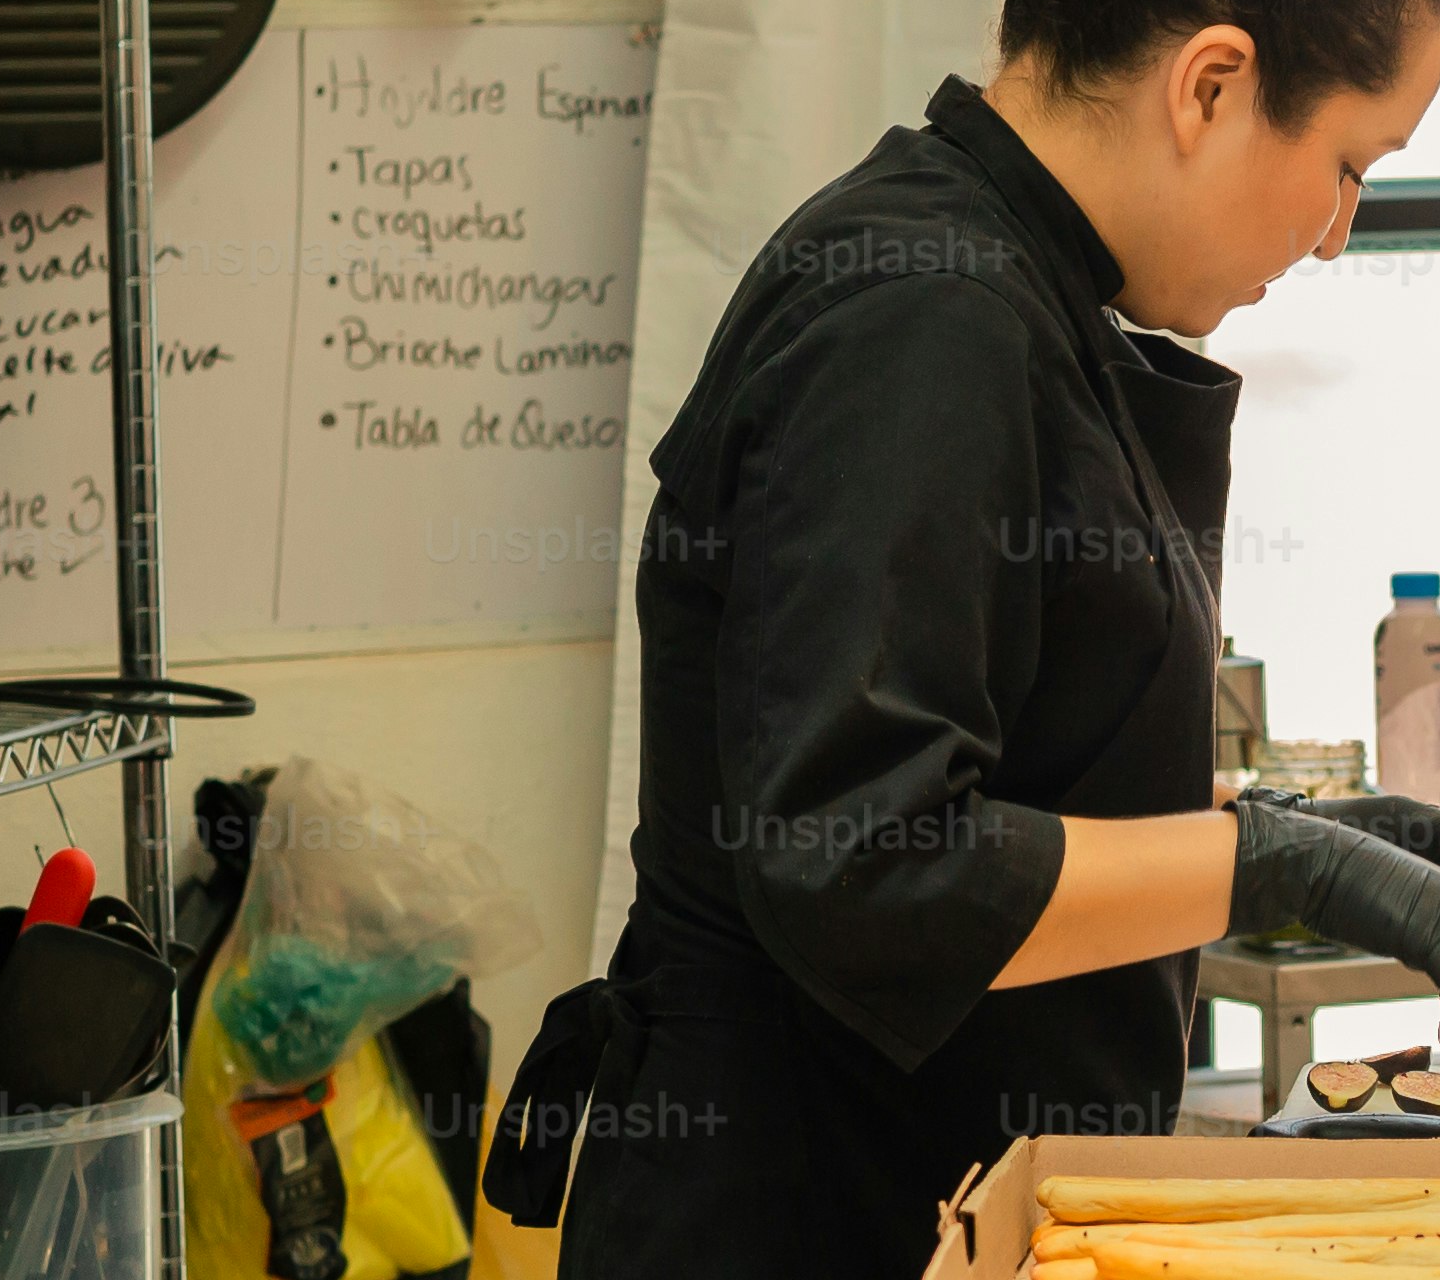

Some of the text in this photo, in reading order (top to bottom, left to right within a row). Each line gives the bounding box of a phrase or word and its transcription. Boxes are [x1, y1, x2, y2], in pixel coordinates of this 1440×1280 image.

[343, 144, 473, 201] Tapas
[339, 314, 482, 371] Brioche
[342, 399, 439, 451] Tabla
[461, 403, 502, 451] de
[68, 474, 106, 537] 3
